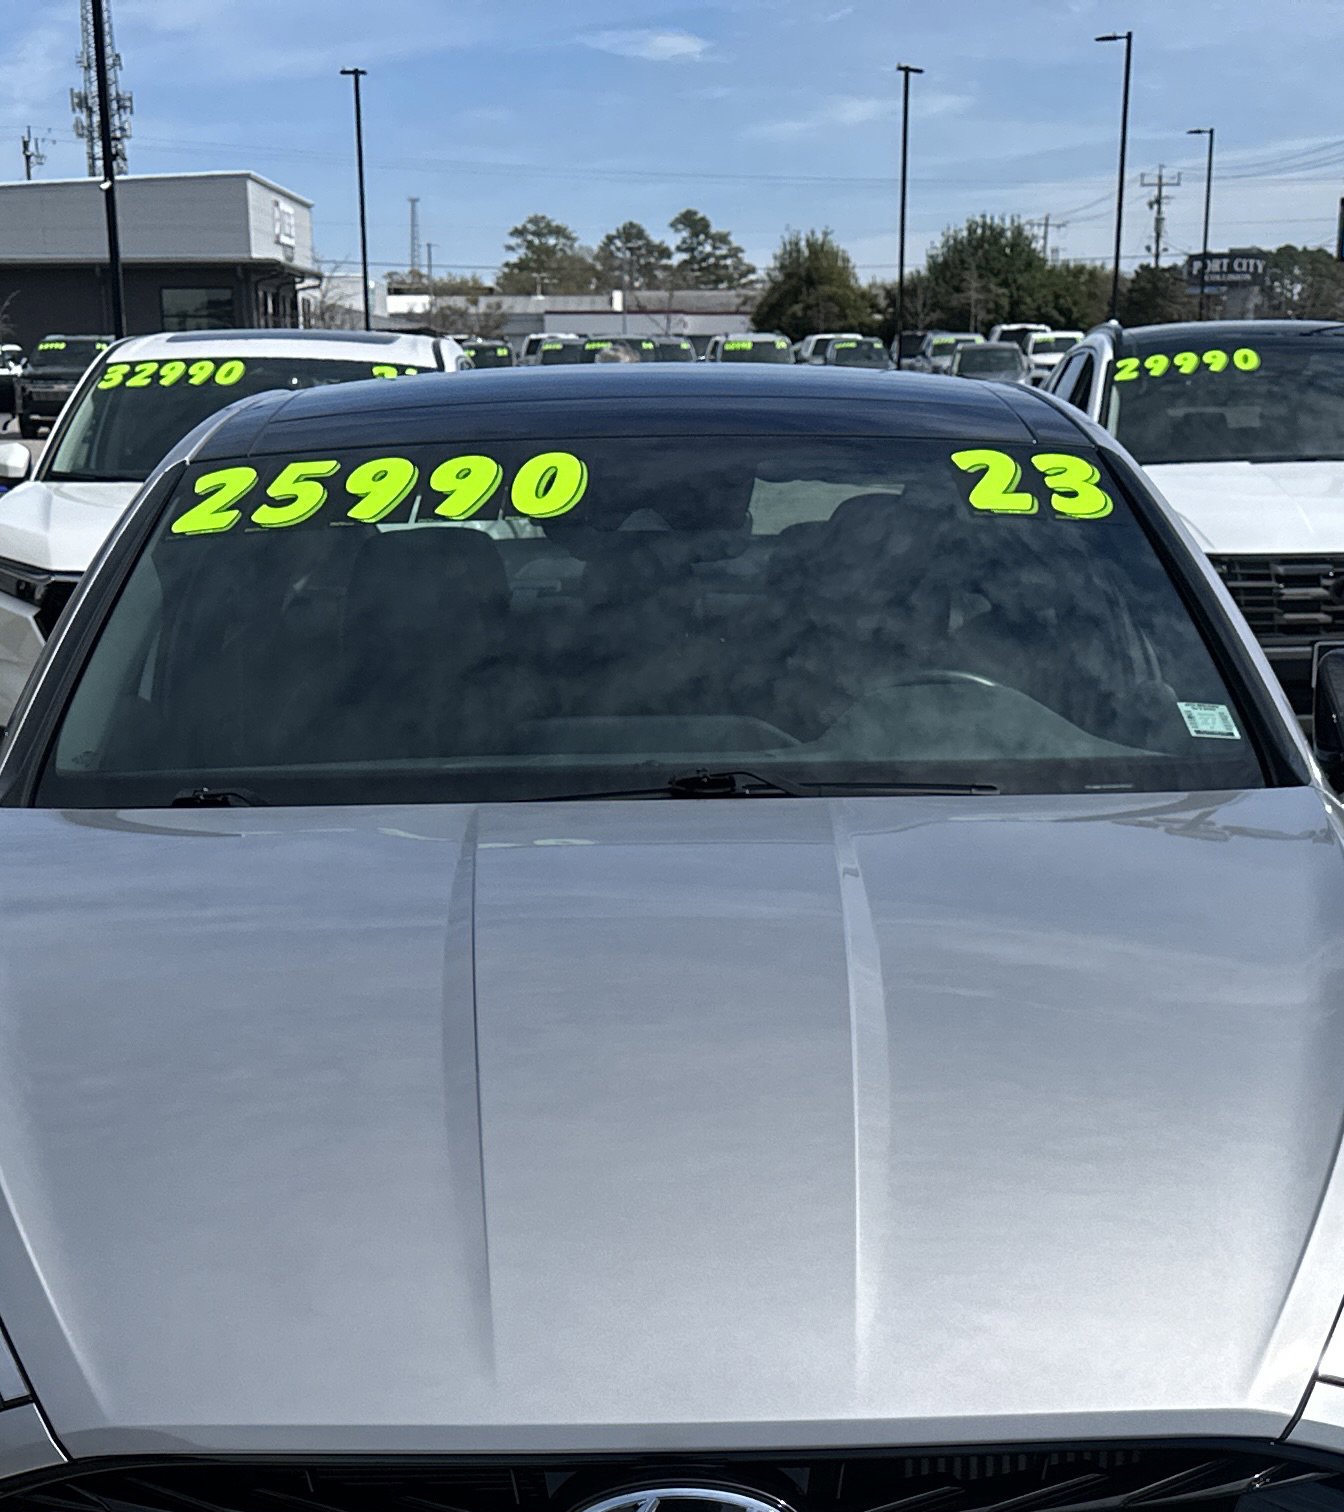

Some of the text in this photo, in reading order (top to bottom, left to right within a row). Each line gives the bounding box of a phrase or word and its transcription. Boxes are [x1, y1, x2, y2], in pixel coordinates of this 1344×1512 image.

[97, 359, 247, 390] 32990
[1113, 347, 1261, 382] 29990
[170, 449, 1114, 536] 25990 23
